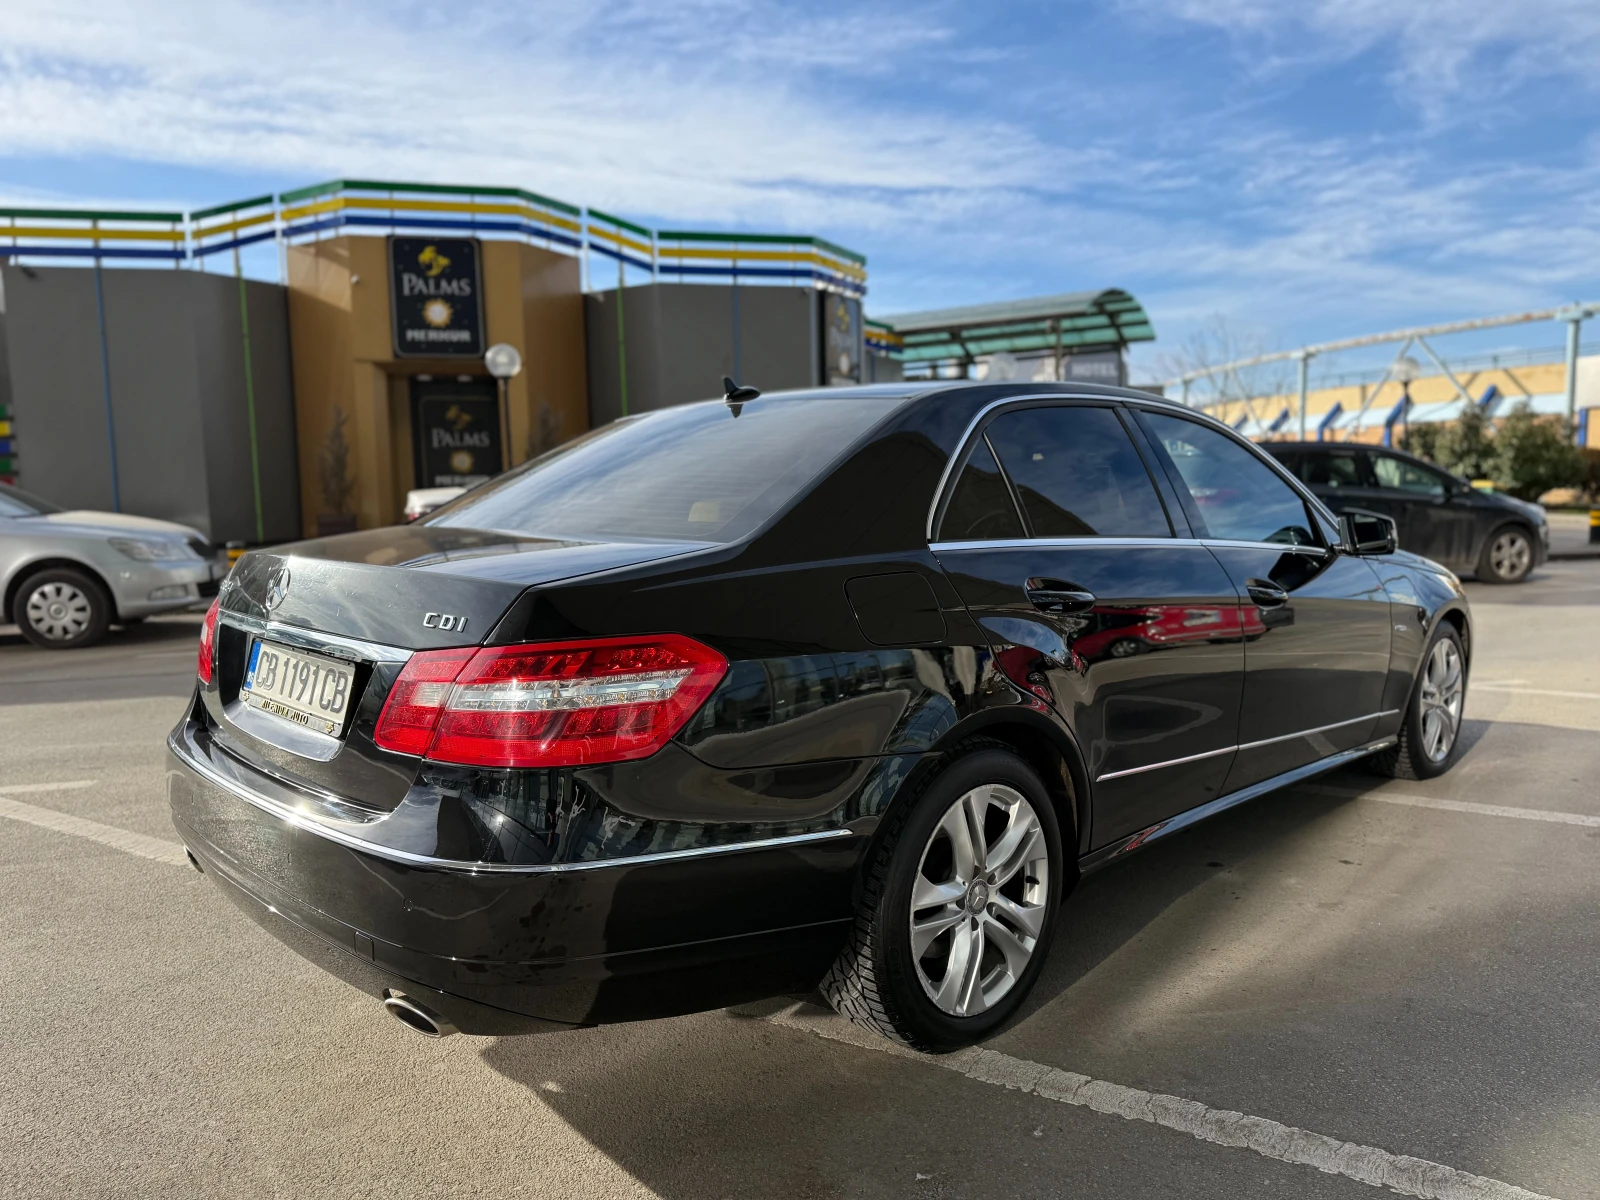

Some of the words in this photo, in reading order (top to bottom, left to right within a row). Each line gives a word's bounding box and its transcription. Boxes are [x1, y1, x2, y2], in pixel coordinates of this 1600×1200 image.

[402, 272, 472, 297] PALMS
[431, 427, 490, 449] PALMS
[423, 612, 469, 633] CDI
